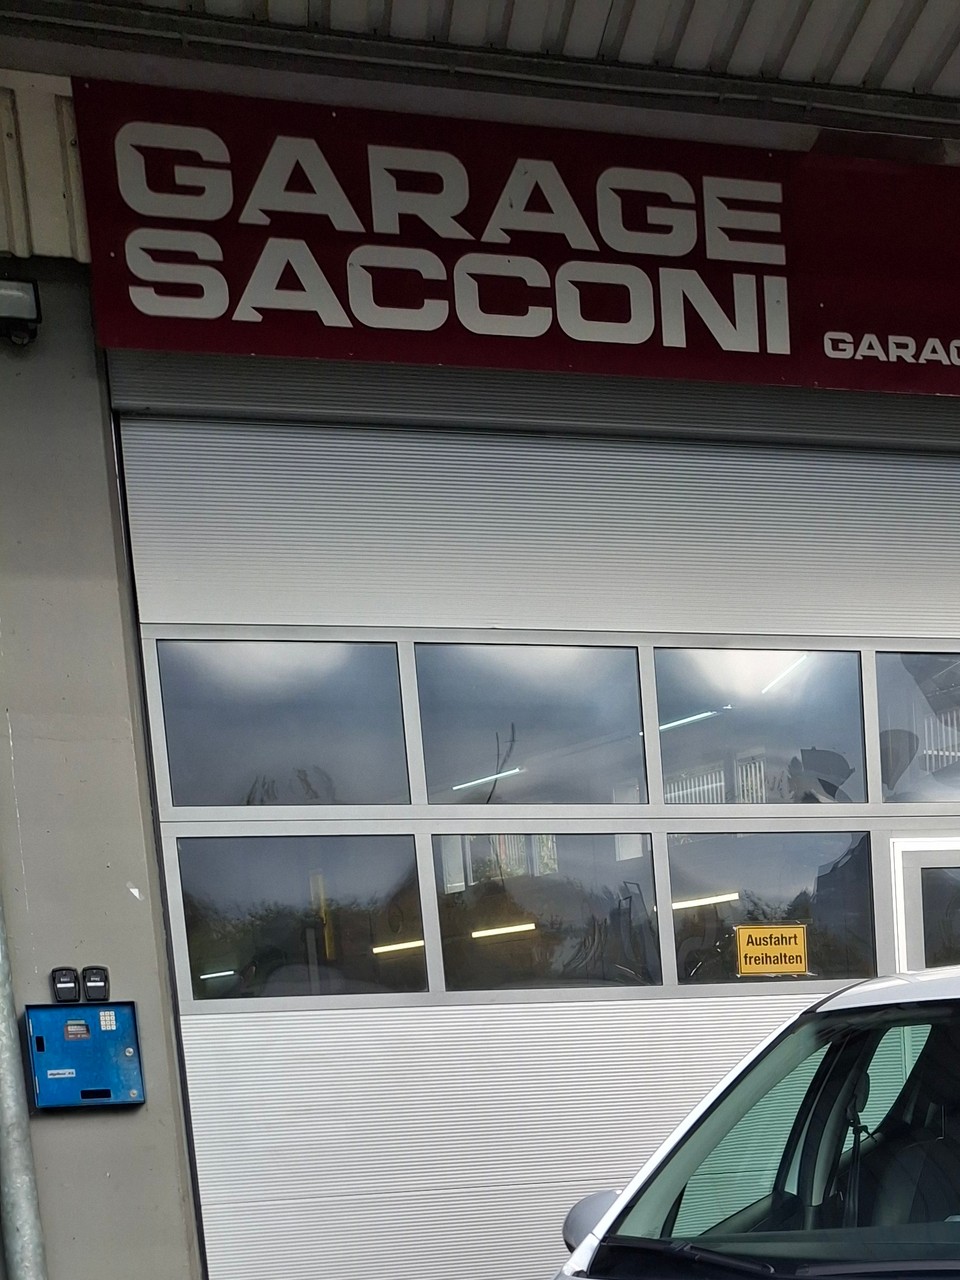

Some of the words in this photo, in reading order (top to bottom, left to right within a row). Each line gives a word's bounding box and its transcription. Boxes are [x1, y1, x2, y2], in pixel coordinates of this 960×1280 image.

[114, 120, 787, 265] GARAGE
[124, 227, 791, 355] SACCONI
[743, 952, 803, 966] freihalten
[746, 933, 799, 946] Ausfahrt
